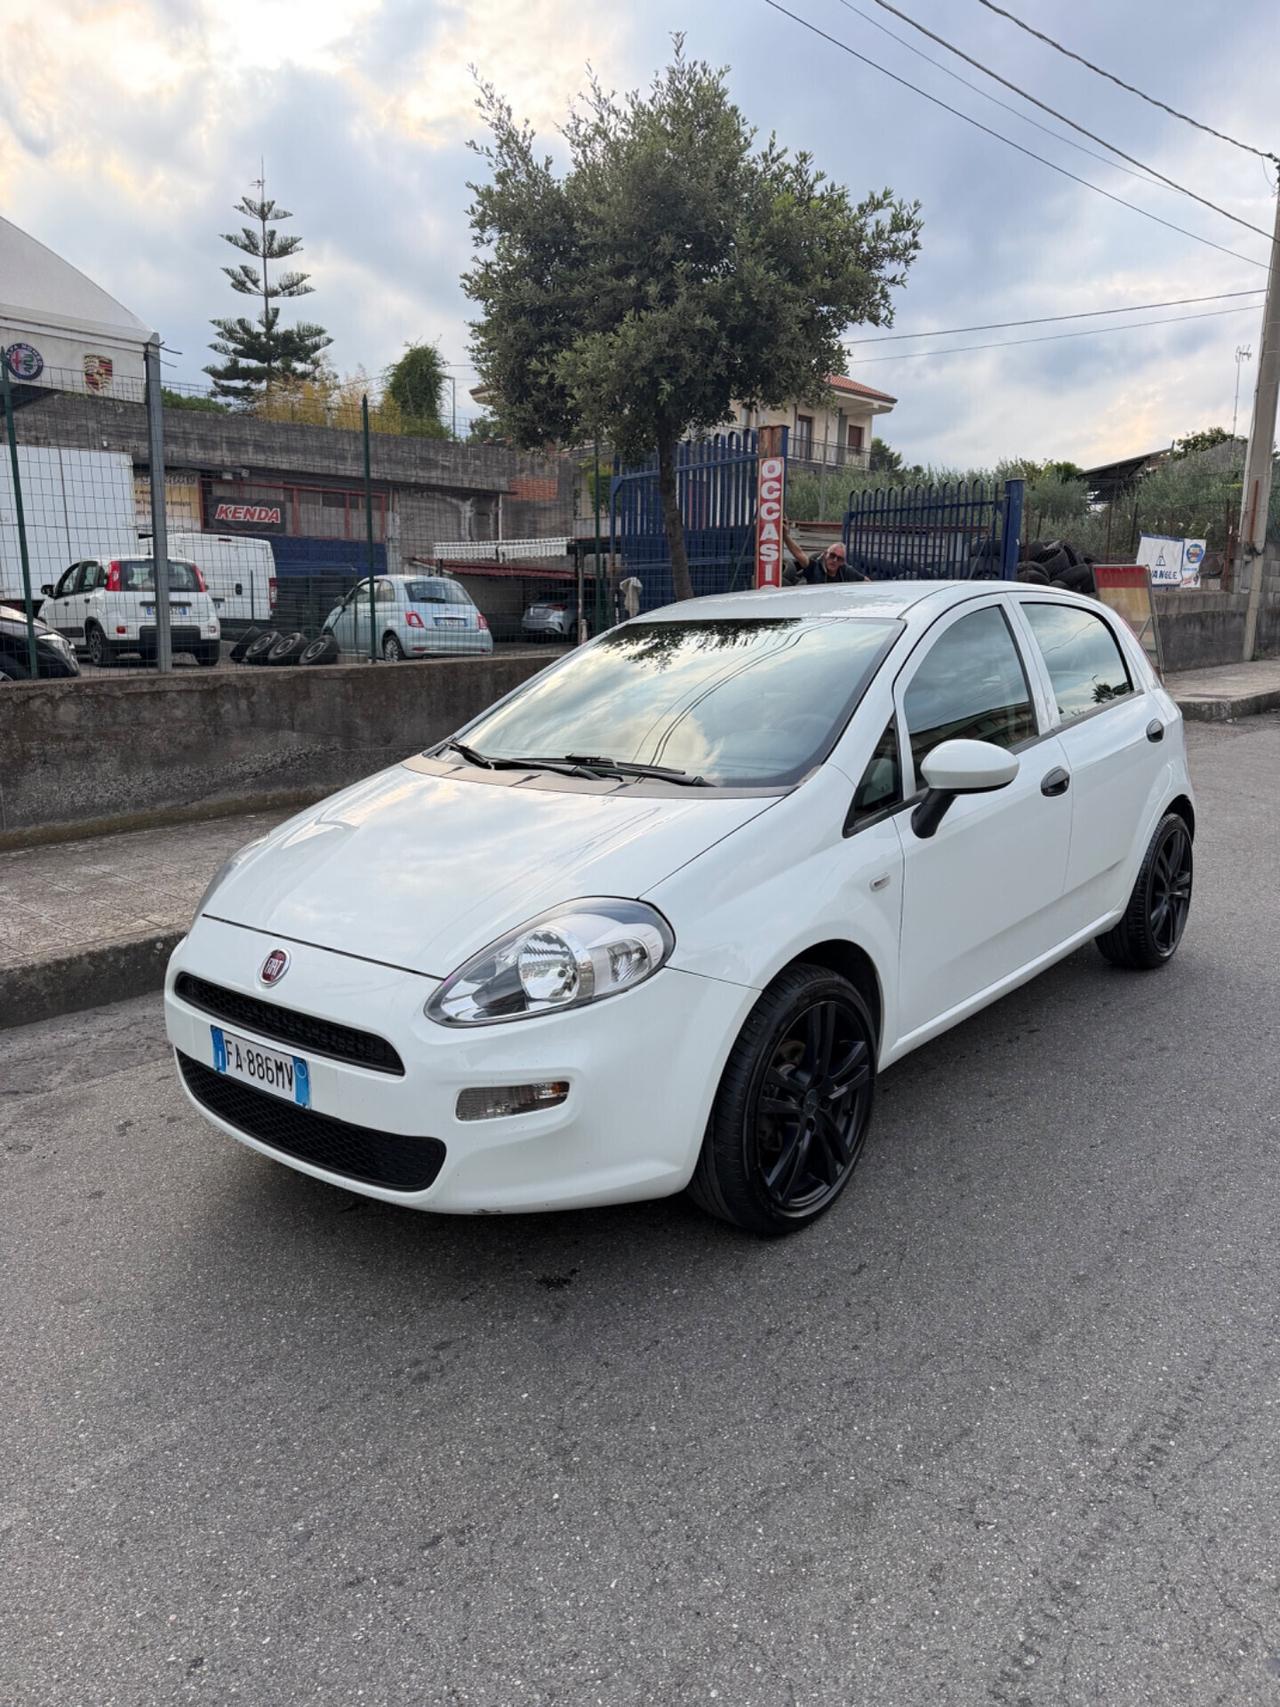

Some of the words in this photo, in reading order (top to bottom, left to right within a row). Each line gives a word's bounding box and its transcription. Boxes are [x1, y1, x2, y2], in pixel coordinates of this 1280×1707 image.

[215, 504, 281, 523] KENDA
[759, 460, 781, 589] OCCASI
[1152, 570, 1178, 580] ANGLE
